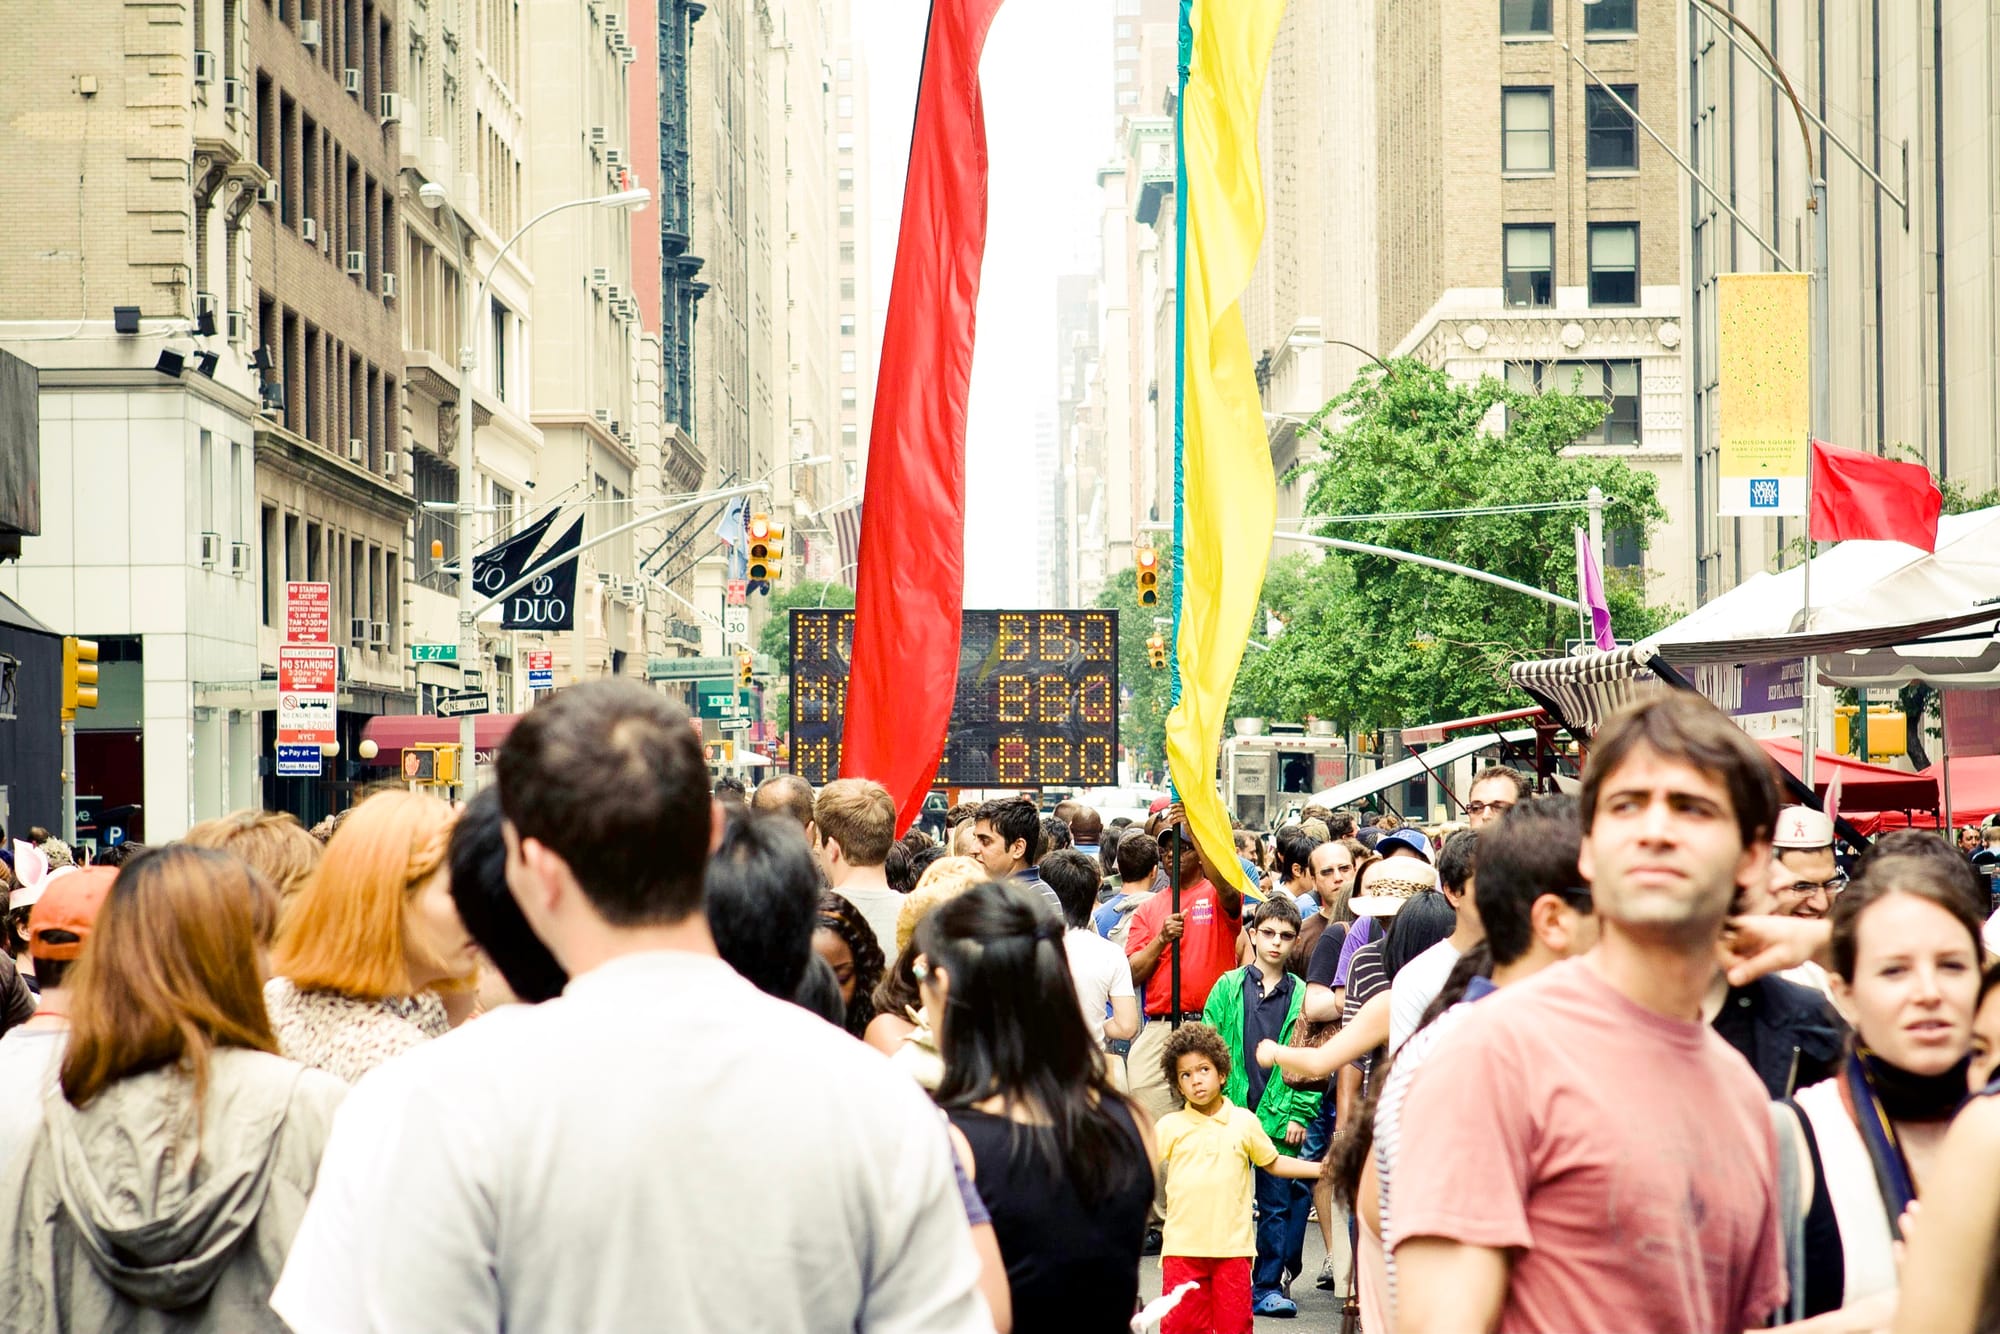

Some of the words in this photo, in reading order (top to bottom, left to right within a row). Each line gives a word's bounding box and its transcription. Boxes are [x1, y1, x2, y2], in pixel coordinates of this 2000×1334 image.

[1755, 481, 1775, 490] NEW
[1752, 488, 1778, 498] YORK
[1755, 496, 1775, 505] LIFE
[299, 585, 328, 593] STANDING
[513, 598, 566, 623] DUO
[728, 622, 745, 633] 30
[999, 614, 1111, 660] BBQ
[416, 646, 423, 660] E
[427, 646, 442, 660] 27
[446, 646, 454, 654] ST
[281, 660, 293, 670] NO
[294, 660, 334, 670] STANDING
[999, 675, 1111, 722] BBQ
[444, 702, 460, 712] ONE
[468, 698, 485, 709] WAY
[288, 749, 301, 758] Pay
[999, 737, 1111, 784] BBQ
[109, 826, 122, 845] P
